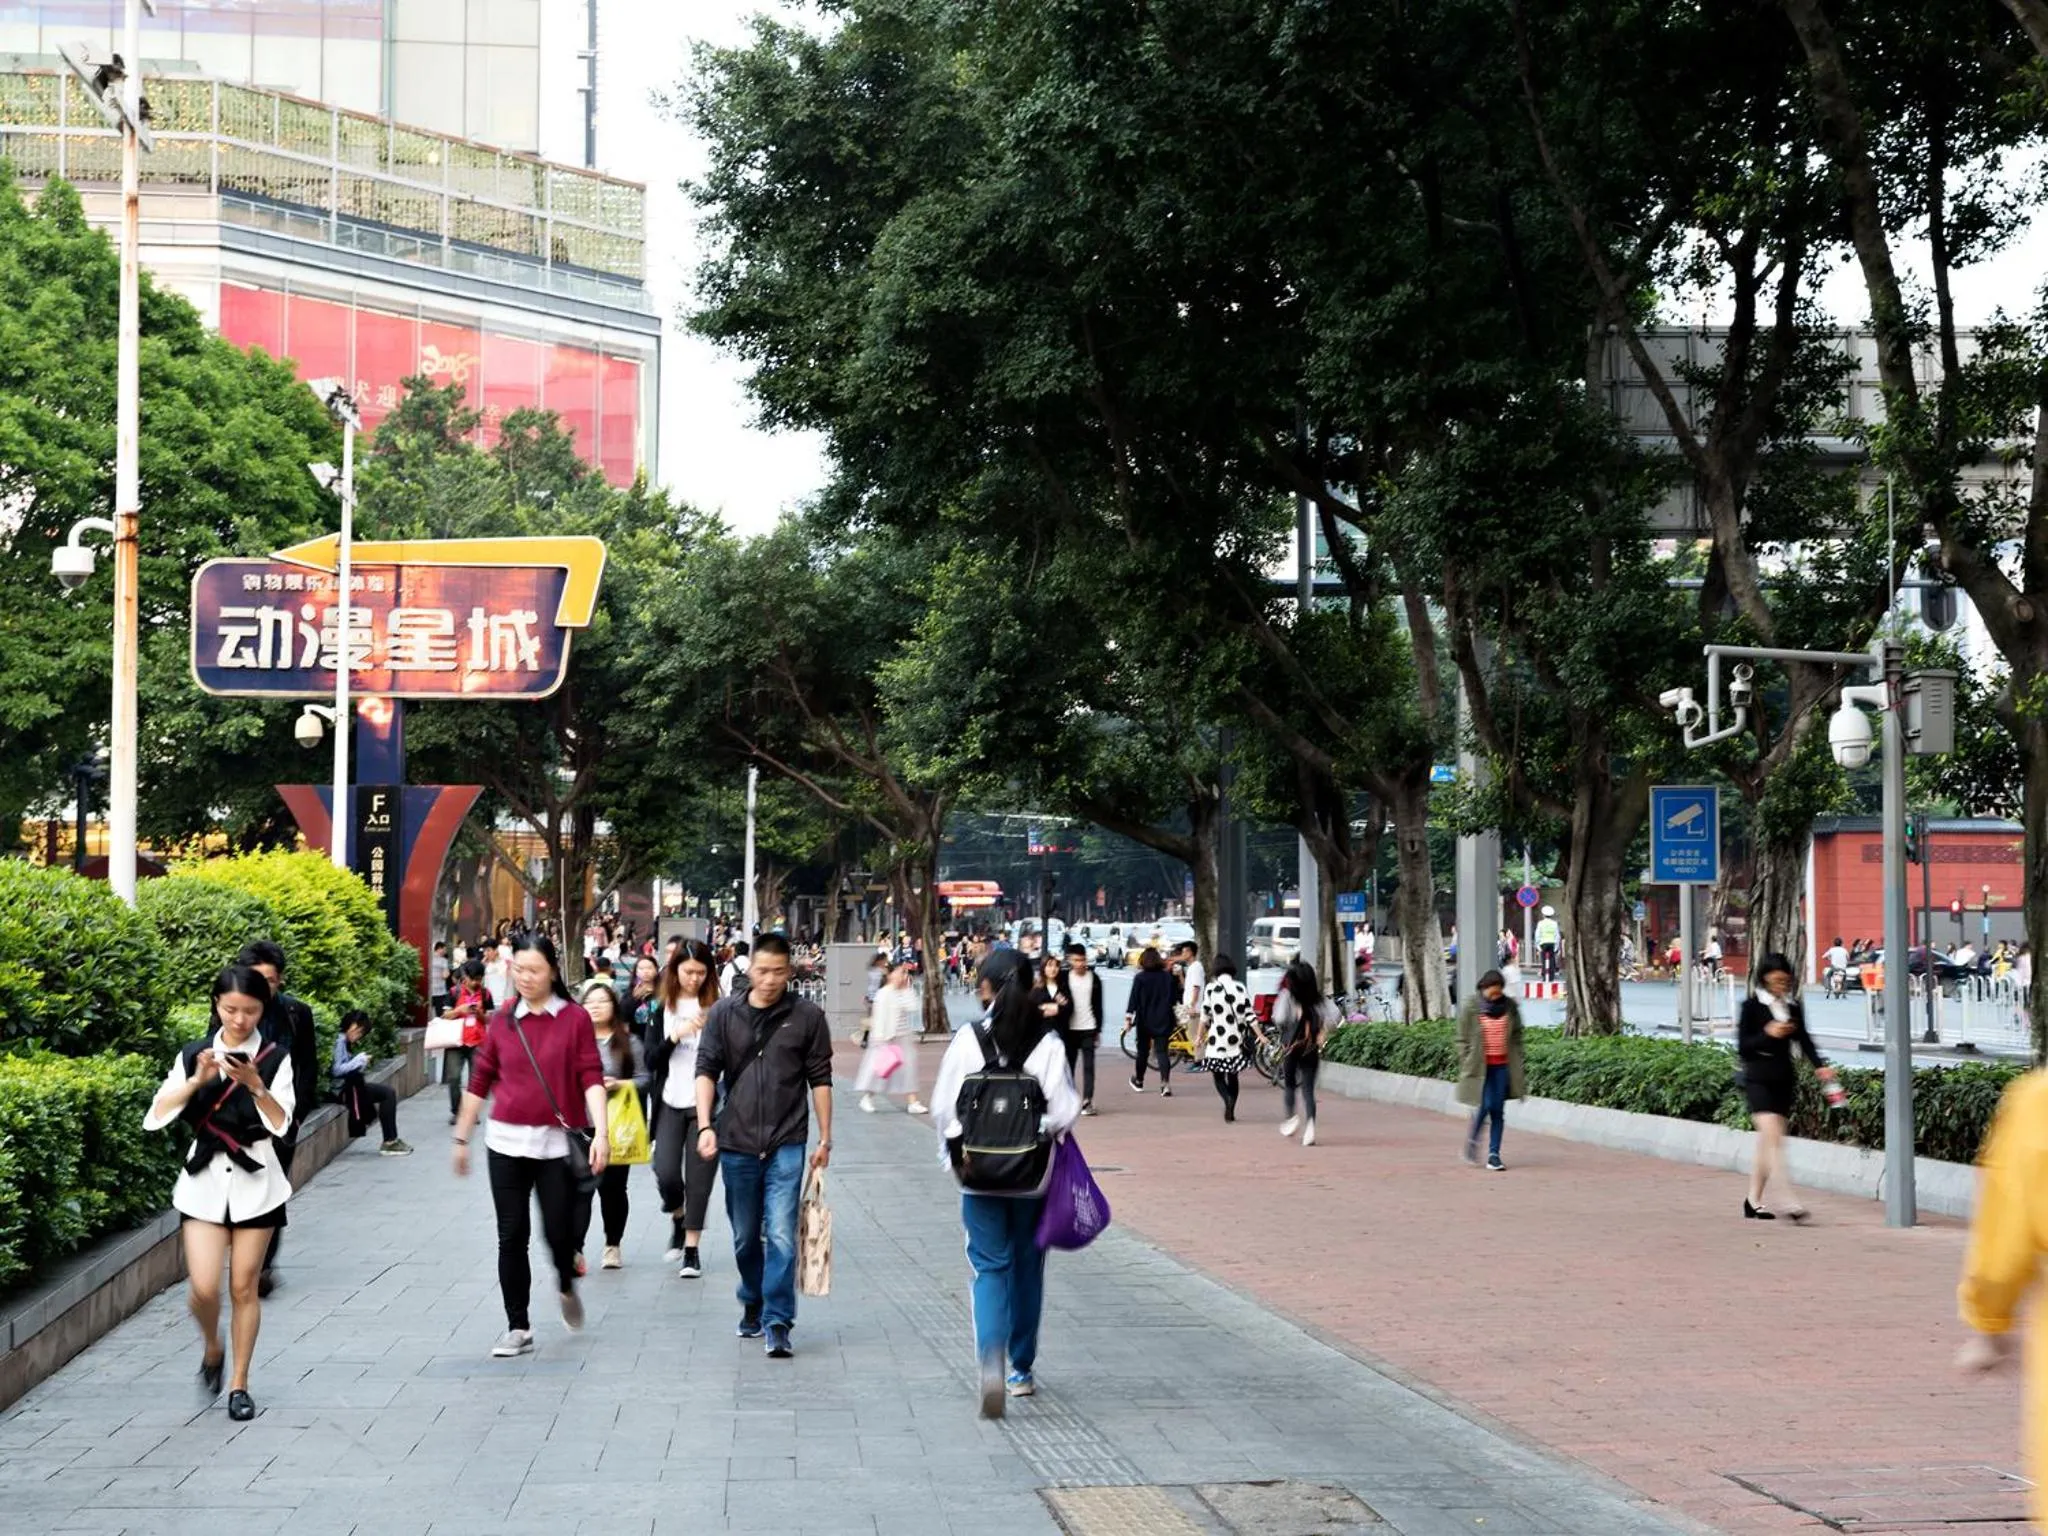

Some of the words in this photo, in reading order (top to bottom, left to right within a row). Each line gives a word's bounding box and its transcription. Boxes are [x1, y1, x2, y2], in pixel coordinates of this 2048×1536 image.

[216, 603, 540, 672] 动漫星城
[372, 794, 386, 812] F
[367, 813, 391, 825] 入口
